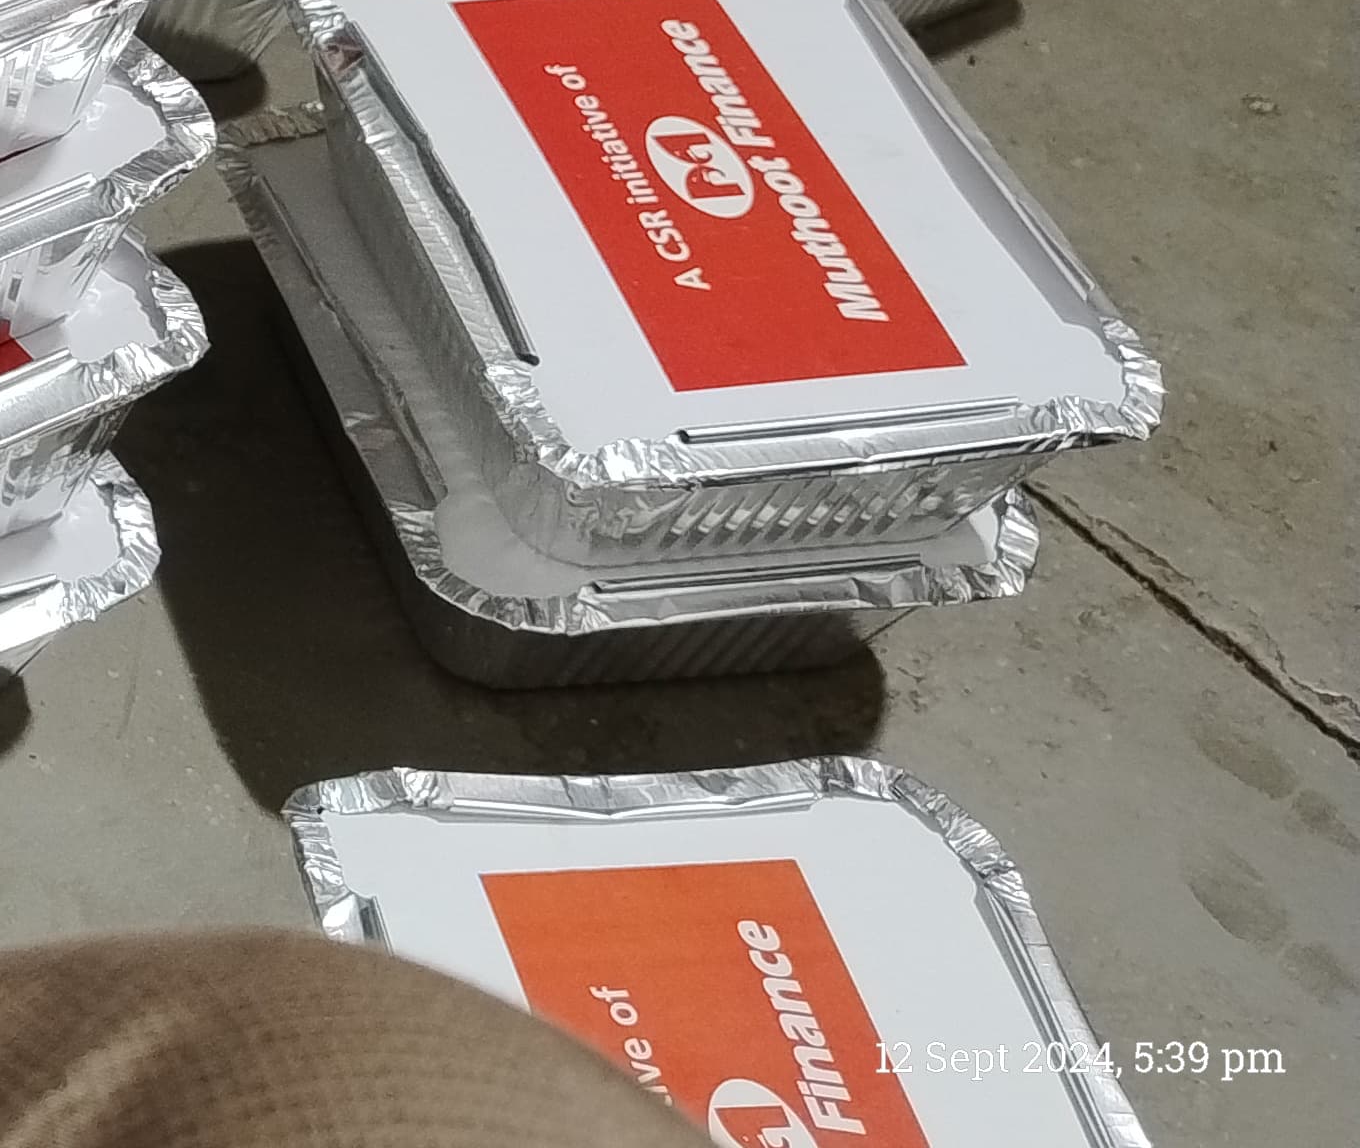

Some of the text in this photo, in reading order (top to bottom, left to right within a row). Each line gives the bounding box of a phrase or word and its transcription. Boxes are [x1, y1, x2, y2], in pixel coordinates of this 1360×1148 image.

[543, 64, 712, 291] A CSR initiative of
[660, 18, 891, 323] Muthoot Finance
[589, 986, 640, 1026] of
[737, 919, 867, 1135] Finance
